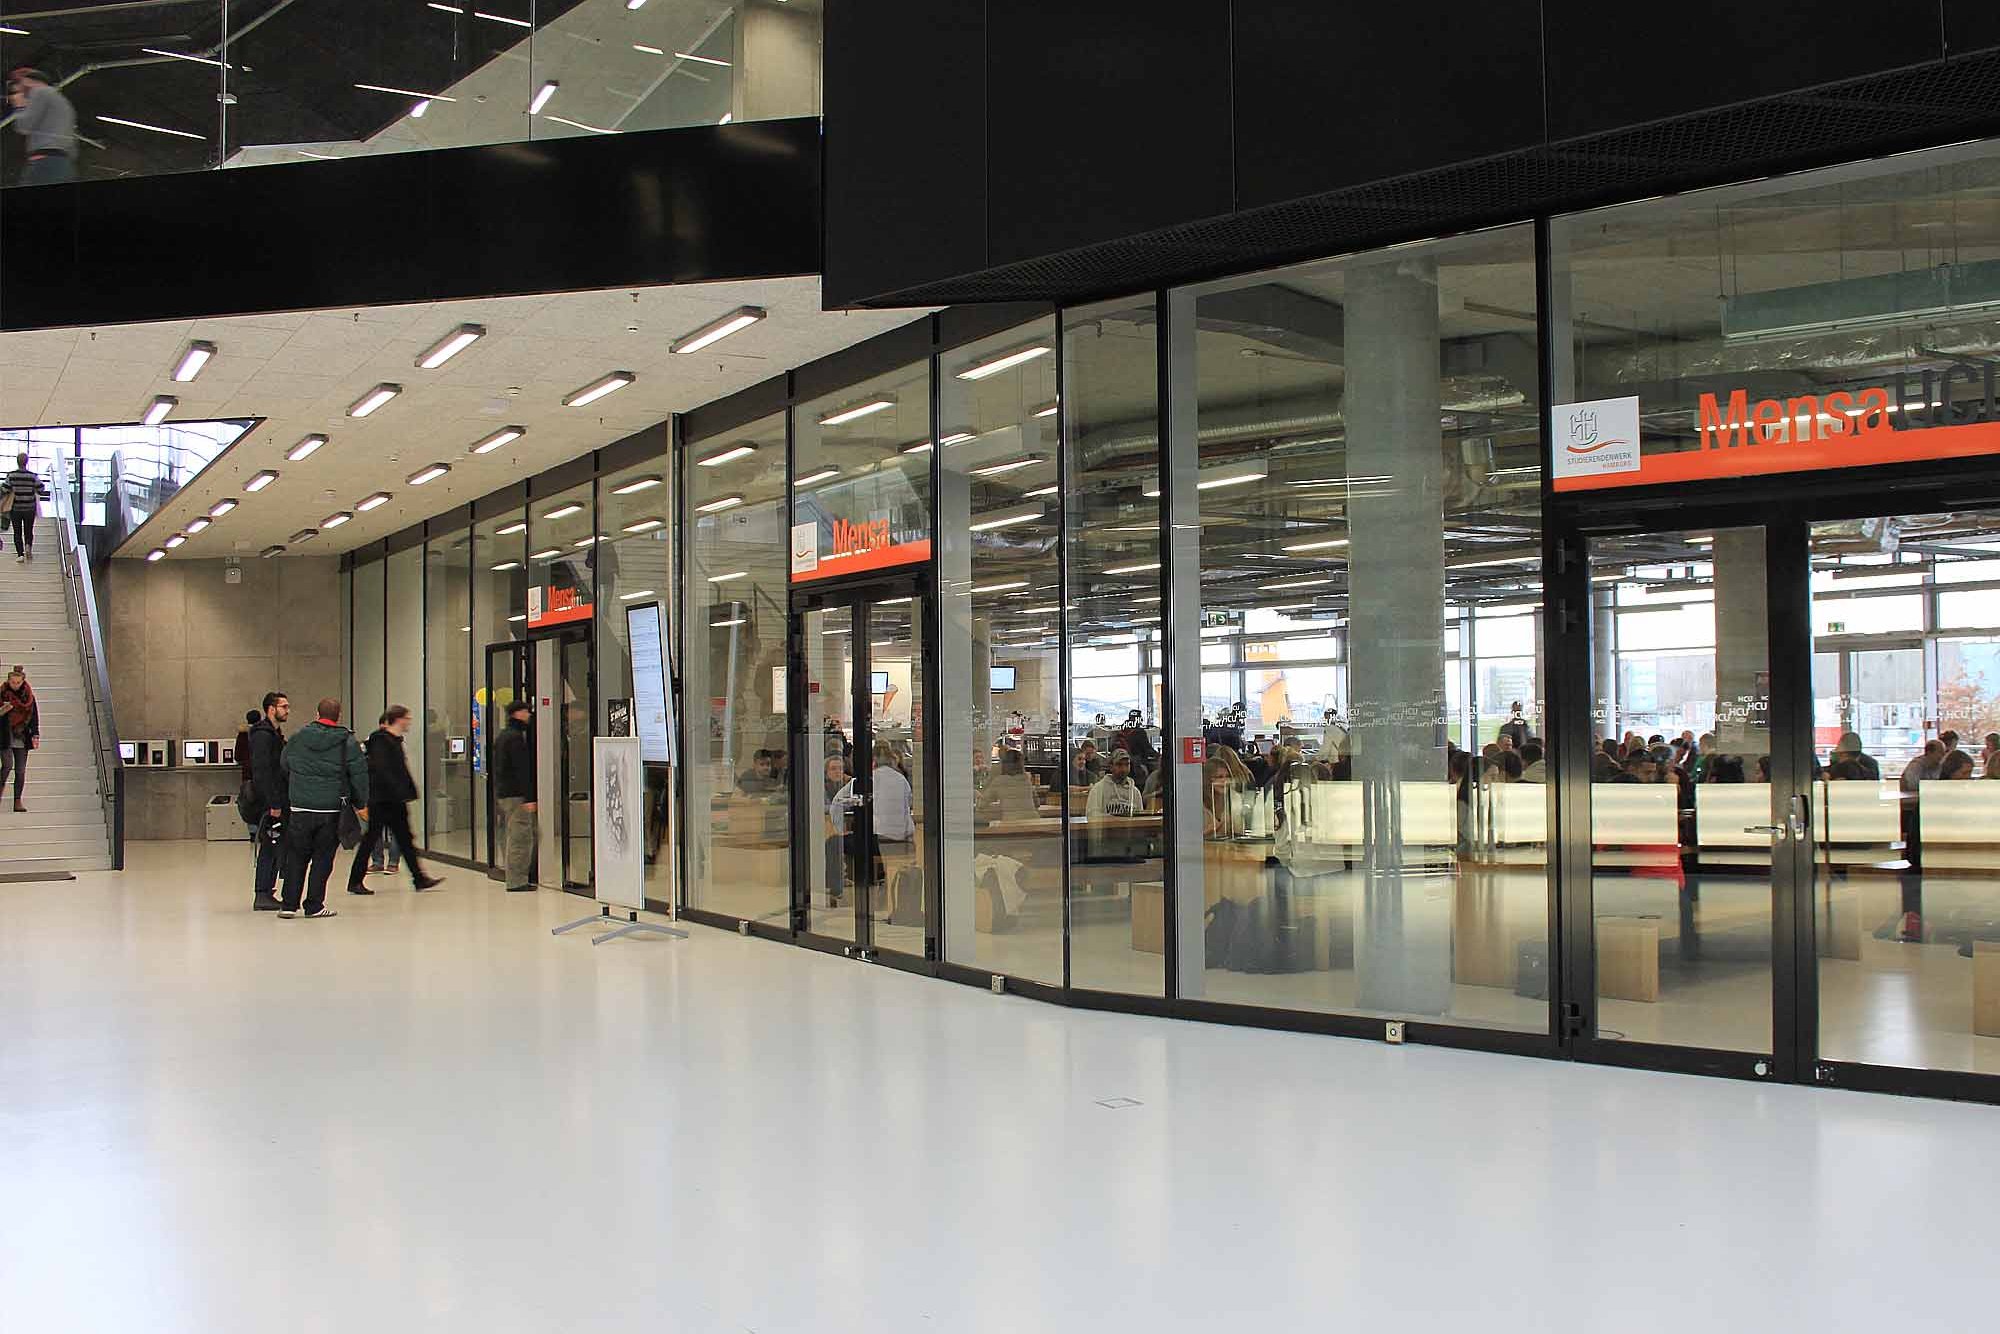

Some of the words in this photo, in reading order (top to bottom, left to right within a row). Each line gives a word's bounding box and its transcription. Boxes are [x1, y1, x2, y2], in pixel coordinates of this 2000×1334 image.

[1698, 386, 1893, 451] Mensa
[832, 517, 889, 554] Mensa
[547, 585, 576, 613] Mensa
[1747, 702, 1768, 711] HCU
[1728, 708, 1749, 717] HCU
[1222, 715, 1237, 723] HCU
[1432, 716, 1448, 725] HCU
[1123, 720, 1137, 729] HCU
[1209, 720, 1224, 728] HCU
